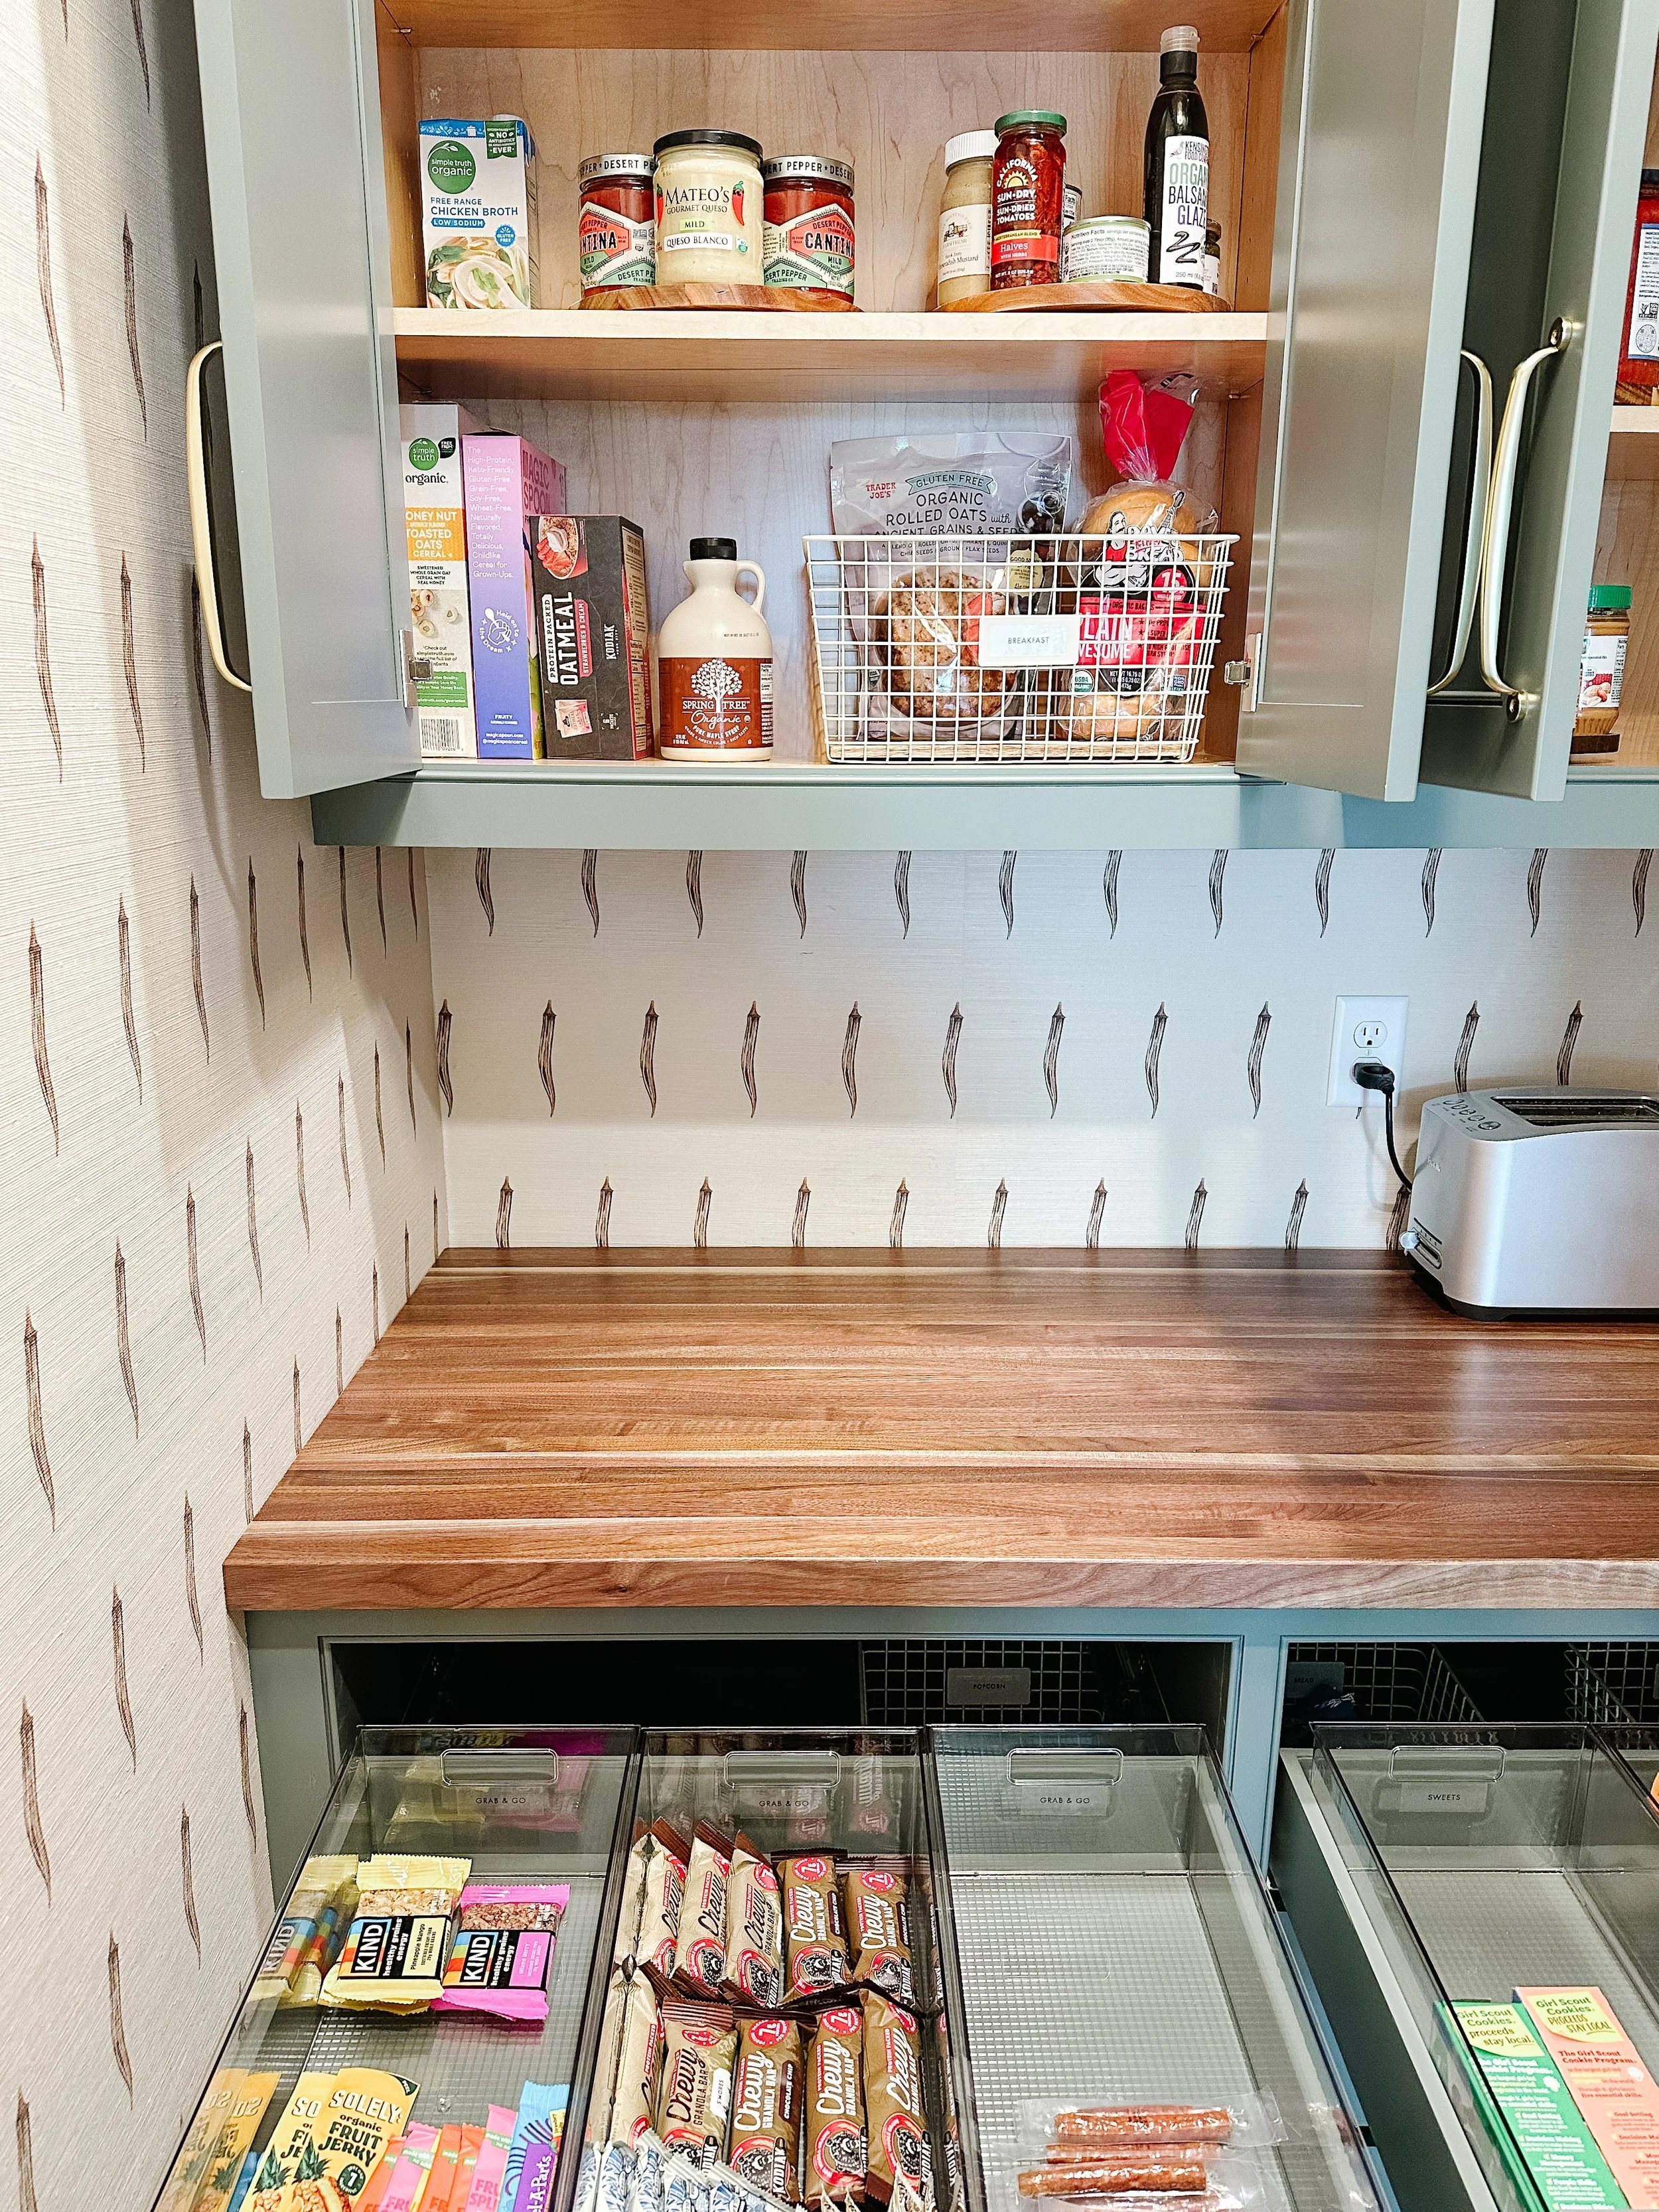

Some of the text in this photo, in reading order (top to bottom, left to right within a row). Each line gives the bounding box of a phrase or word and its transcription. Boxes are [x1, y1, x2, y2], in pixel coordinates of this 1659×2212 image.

[431, 158, 454, 167] simple
[604, 159, 639, 170] DESERT
[786, 161, 822, 173] PEPPER
[432, 166, 472, 177] organic
[997, 158, 1039, 187] CALIFORNIA
[665, 186, 729, 208] MATEO'S
[431, 206, 518, 216] CHICKEN BROTH
[667, 204, 727, 214] GOURMET QUESO
[997, 203, 1036, 216] SUN-DRIED
[812, 220, 835, 230] DESERT
[997, 212, 1035, 225] TOMATOES
[667, 236, 728, 248] QUESO BLANCO
[1000, 242, 1029, 253] Halves
[828, 256, 842, 265] MILD
[618, 269, 643, 281] DESERT
[782, 269, 807, 281] PEPPER
[413, 447, 435, 456] simple
[522, 450, 549, 490] MAGIC
[405, 473, 447, 485] organic
[916, 474, 984, 488] GLUTEN FREE
[865, 482, 897, 493] TRADER
[869, 490, 891, 499] JOE'S
[469, 494, 502, 504] Soy-Free,
[916, 491, 984, 507] ORGANIC
[436, 511, 457, 521] NUT
[470, 514, 502, 522] Naturally
[886, 507, 1012, 527] ROLLED OATS with
[407, 529, 452, 539] TOASTED
[471, 532, 494, 542] Totally
[978, 526, 984, 534] &
[415, 540, 443, 549] OATS
[472, 542, 504, 551] Delicious,
[473, 571, 514, 579] Grown-Ups.
[496, 609, 512, 621] Hold
[510, 619, 518, 628] on
[482, 638, 503, 653] Dream
[545, 599, 556, 678] PROTEIN PACKED
[554, 591, 579, 686] OATMEAL
[604, 624, 617, 660] KODIAK
[579, 629, 591, 674] STRAWBERRIES
[682, 701, 715, 709] SPRING
[691, 709, 742, 730] Organic
[692, 725, 705, 737] PURE
[725, 725, 740, 737] SYRUP
[790, 1884, 819, 1943] Chewy
[831, 1909, 840, 1934] CHOCOLATE
[860, 1894, 889, 1950] Chewy
[899, 1919, 909, 1945] CHOCOLATE
[355, 1924, 383, 1971] KIND
[383, 1917, 403, 1976] healthy grains
[397, 1933, 409, 1961] energy
[411, 1924, 425, 1970] Pineapple Mango
[464, 1936, 490, 1980] KIND
[490, 1931, 509, 1986] healthy grains
[503, 1945, 515, 1972] energy
[765, 1974, 779, 2008] KODIAK
[1536, 1997, 1592, 2008] Girl Scout
[1548, 2014, 1588, 2025] PROCEEDS
[1469, 2028, 1514, 2039] proceeds
[1566, 2021, 1612, 2033] STAY LOCAL
[1483, 2037, 1504, 2047] stay
[816, 2037, 851, 2114] Chewy
[733, 2050, 774, 2132] Chewy
[844, 2057, 856, 2116] GRANOLA BAR
[693, 2069, 709, 2126] GRANOLA BAR
[762, 2069, 777, 2128] GRANOLA BAR
[783, 2085, 792, 2119] CHOCOLATE
[292, 2097, 323, 2118] SO
[340, 2114, 382, 2132] organic
[329, 2122, 383, 2149] FRUIT
[319, 2136, 377, 2168] JERKY
[772, 2147, 786, 2194] KODIAK
